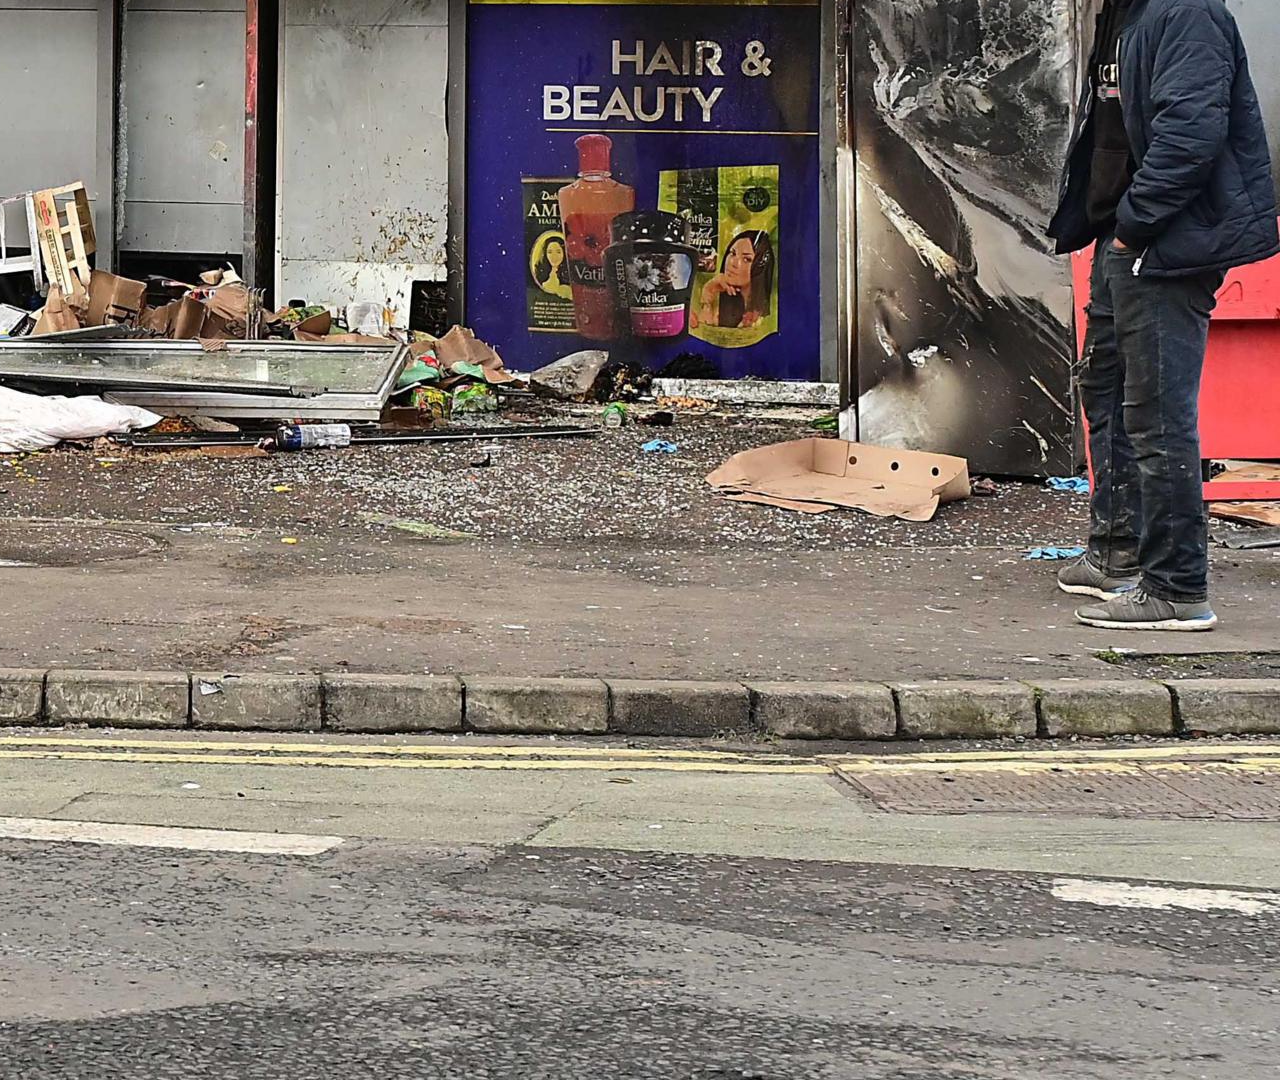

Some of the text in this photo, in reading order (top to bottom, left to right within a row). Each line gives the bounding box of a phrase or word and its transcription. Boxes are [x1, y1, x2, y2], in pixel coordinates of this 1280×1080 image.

[612, 40, 772, 77] HAIR &
[543, 85, 724, 122] BEAUTY
[633, 291, 666, 304] Vatika
